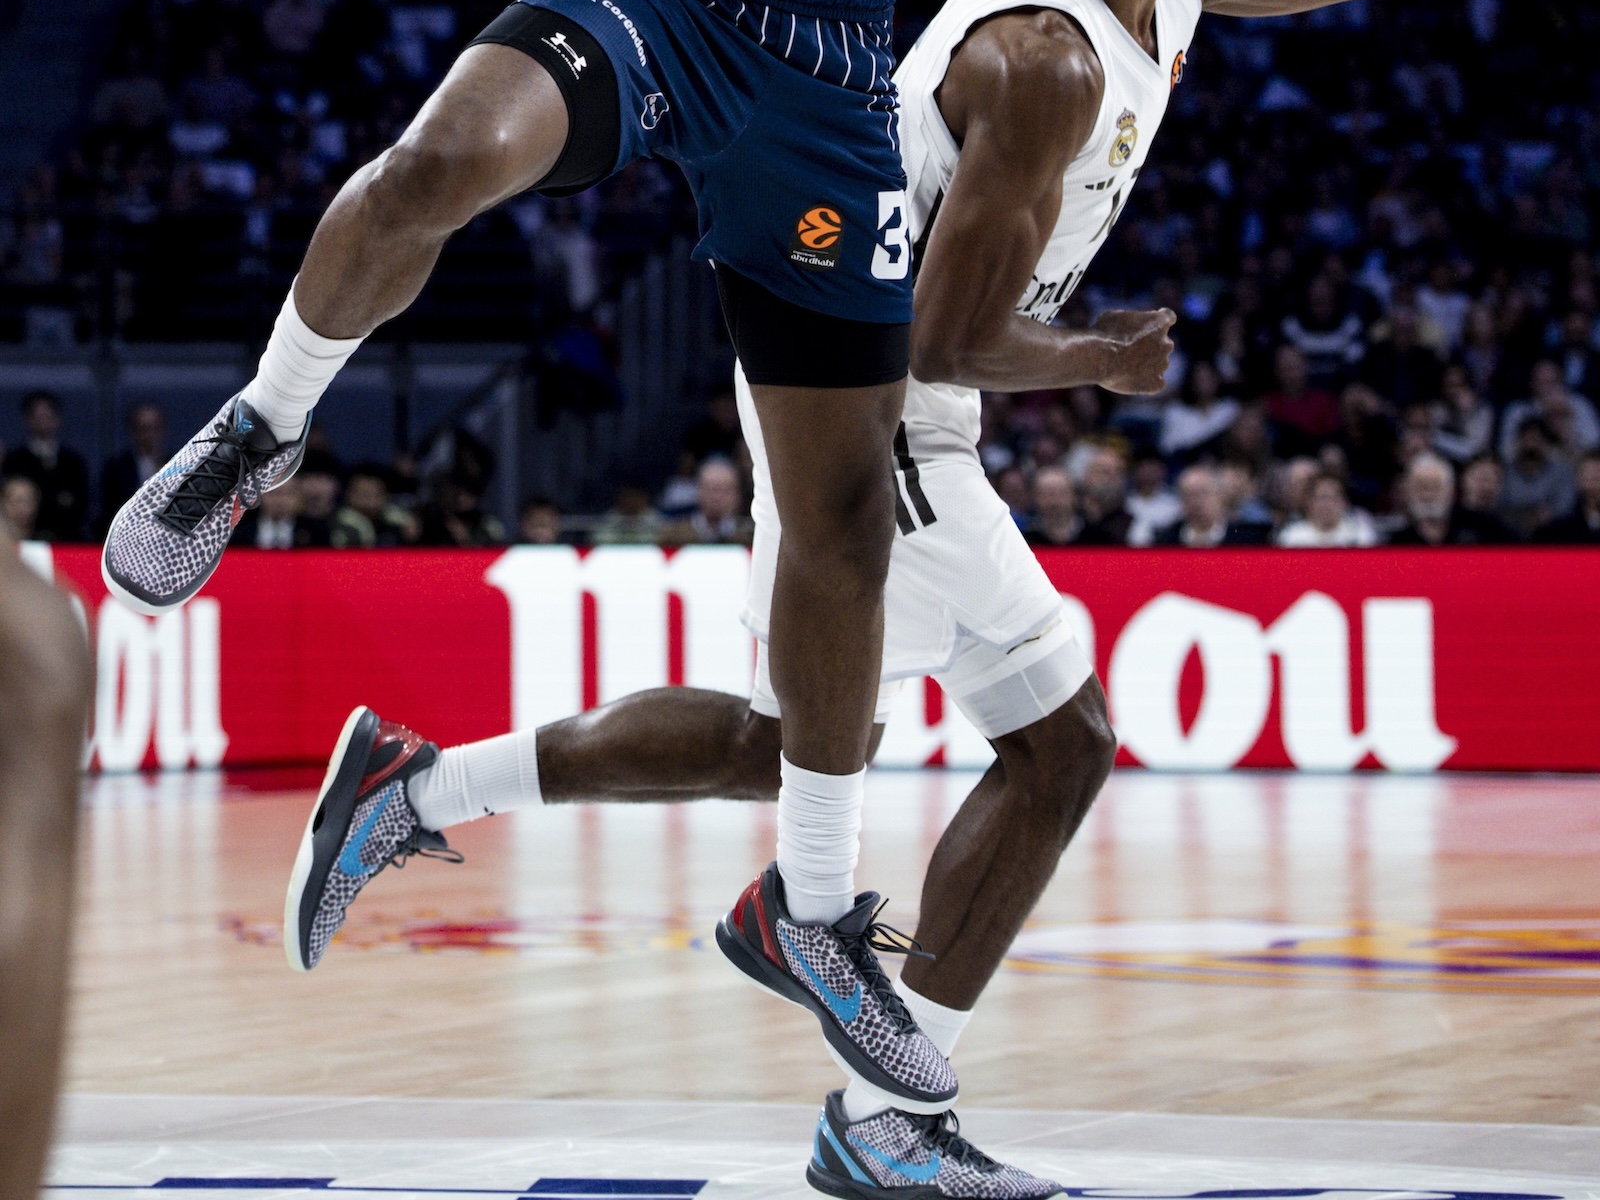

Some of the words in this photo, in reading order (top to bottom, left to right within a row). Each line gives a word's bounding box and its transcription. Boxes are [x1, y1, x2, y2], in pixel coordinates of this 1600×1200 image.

[602, 0, 647, 68] corendon
[791, 254, 808, 263] abu
[809, 257, 835, 267] dhabi
[871, 189, 910, 280] 3
